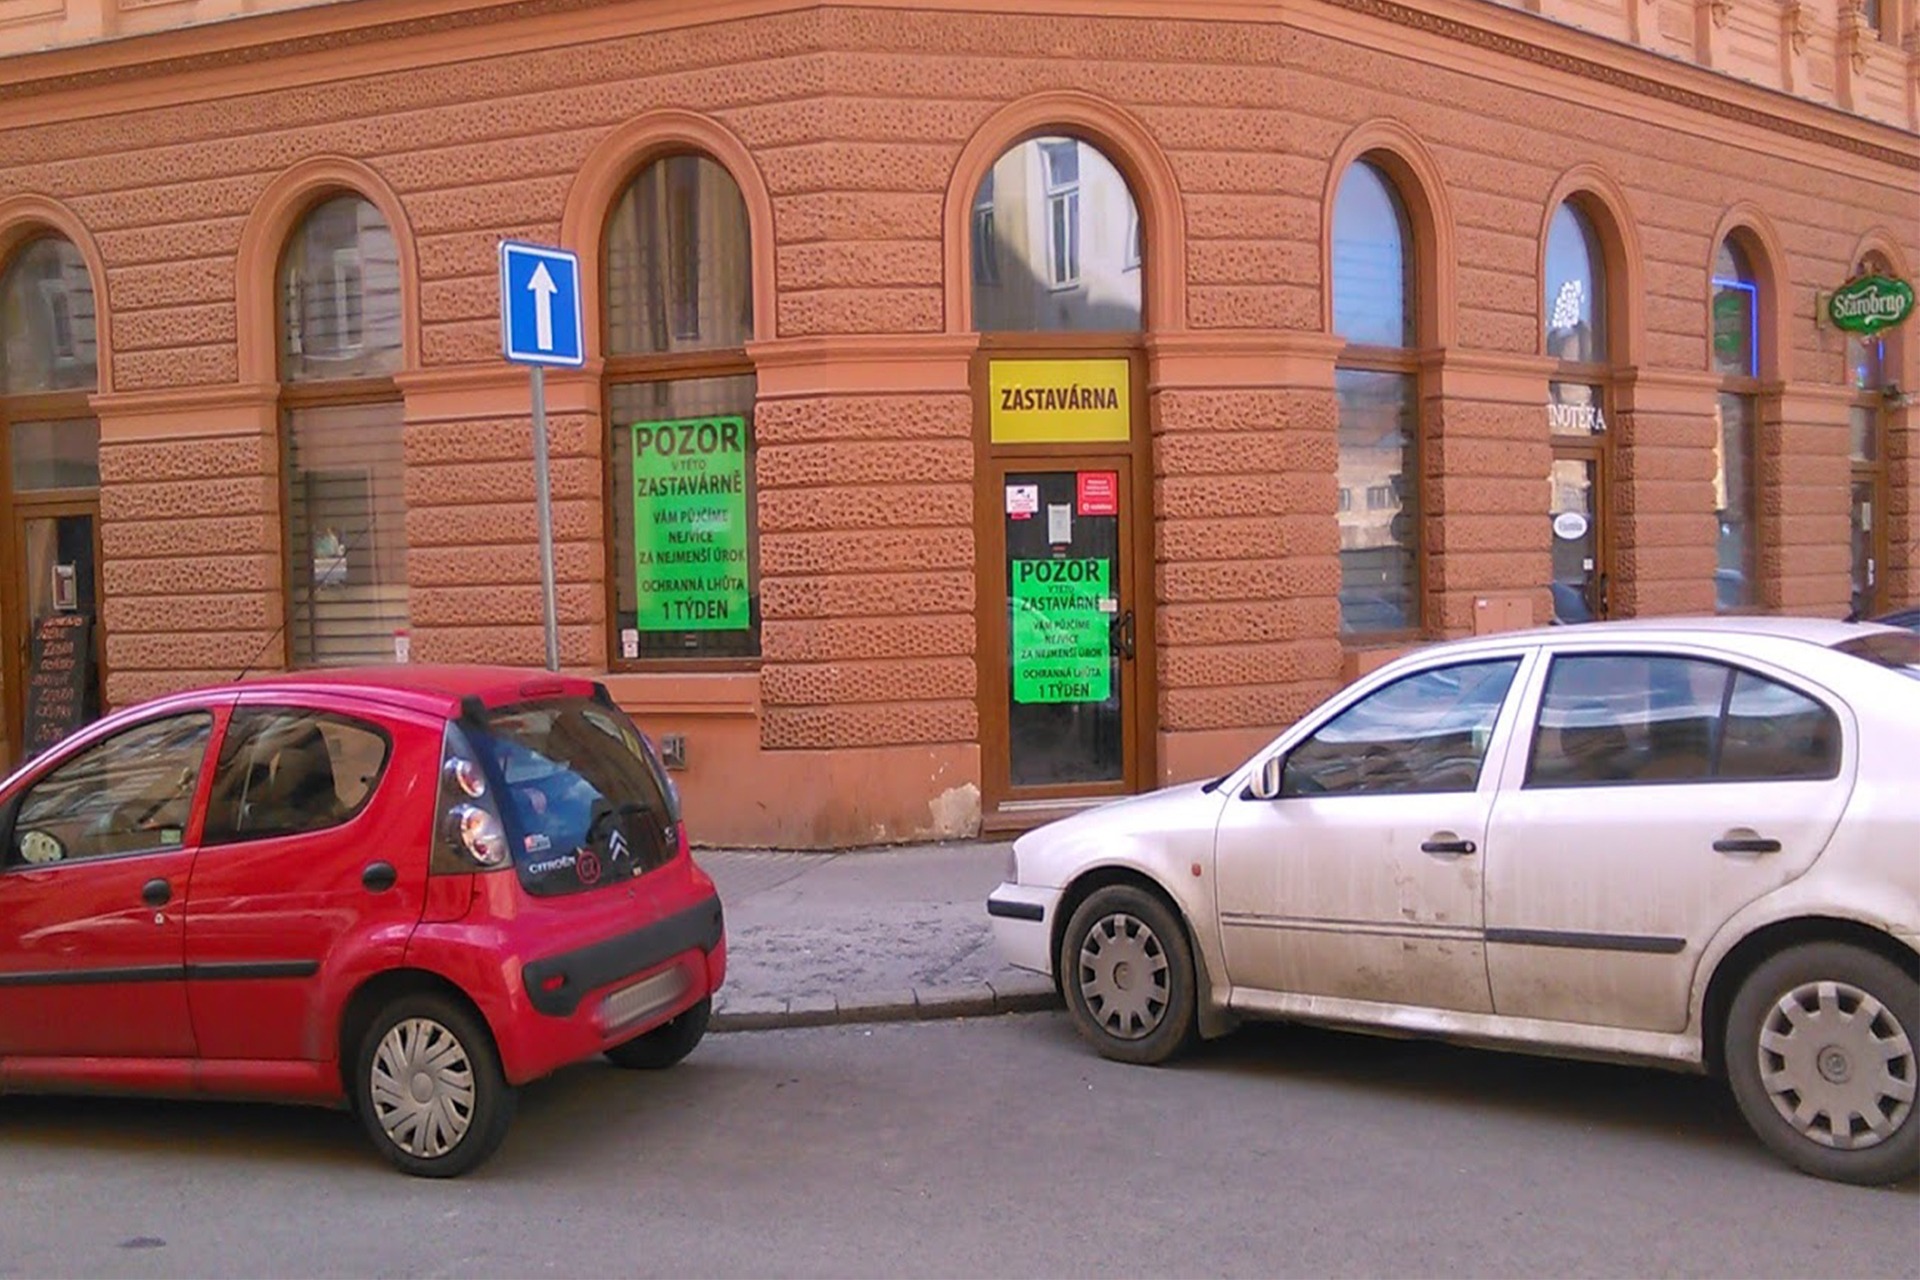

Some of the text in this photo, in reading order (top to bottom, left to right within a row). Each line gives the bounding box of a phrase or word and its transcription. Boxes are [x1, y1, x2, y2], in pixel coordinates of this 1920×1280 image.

[1834, 285, 1905, 325] Starobrno
[1001, 383, 1119, 410] ZASTAVÁRNA
[636, 422, 742, 457] POZOR
[638, 469, 743, 497] ZASTAVÁRNĚ
[653, 507, 678, 524] VÁM
[640, 546, 746, 565] ZA NEJMENŠÍ ÚROK
[1020, 562, 1101, 583] POZOR
[641, 576, 705, 593] OCHRANNÁ
[662, 597, 729, 620] 1 TÝDEN
[1023, 666, 1072, 679] OCHRANNÁ
[1038, 680, 1090, 698] 1 TÝDEN
